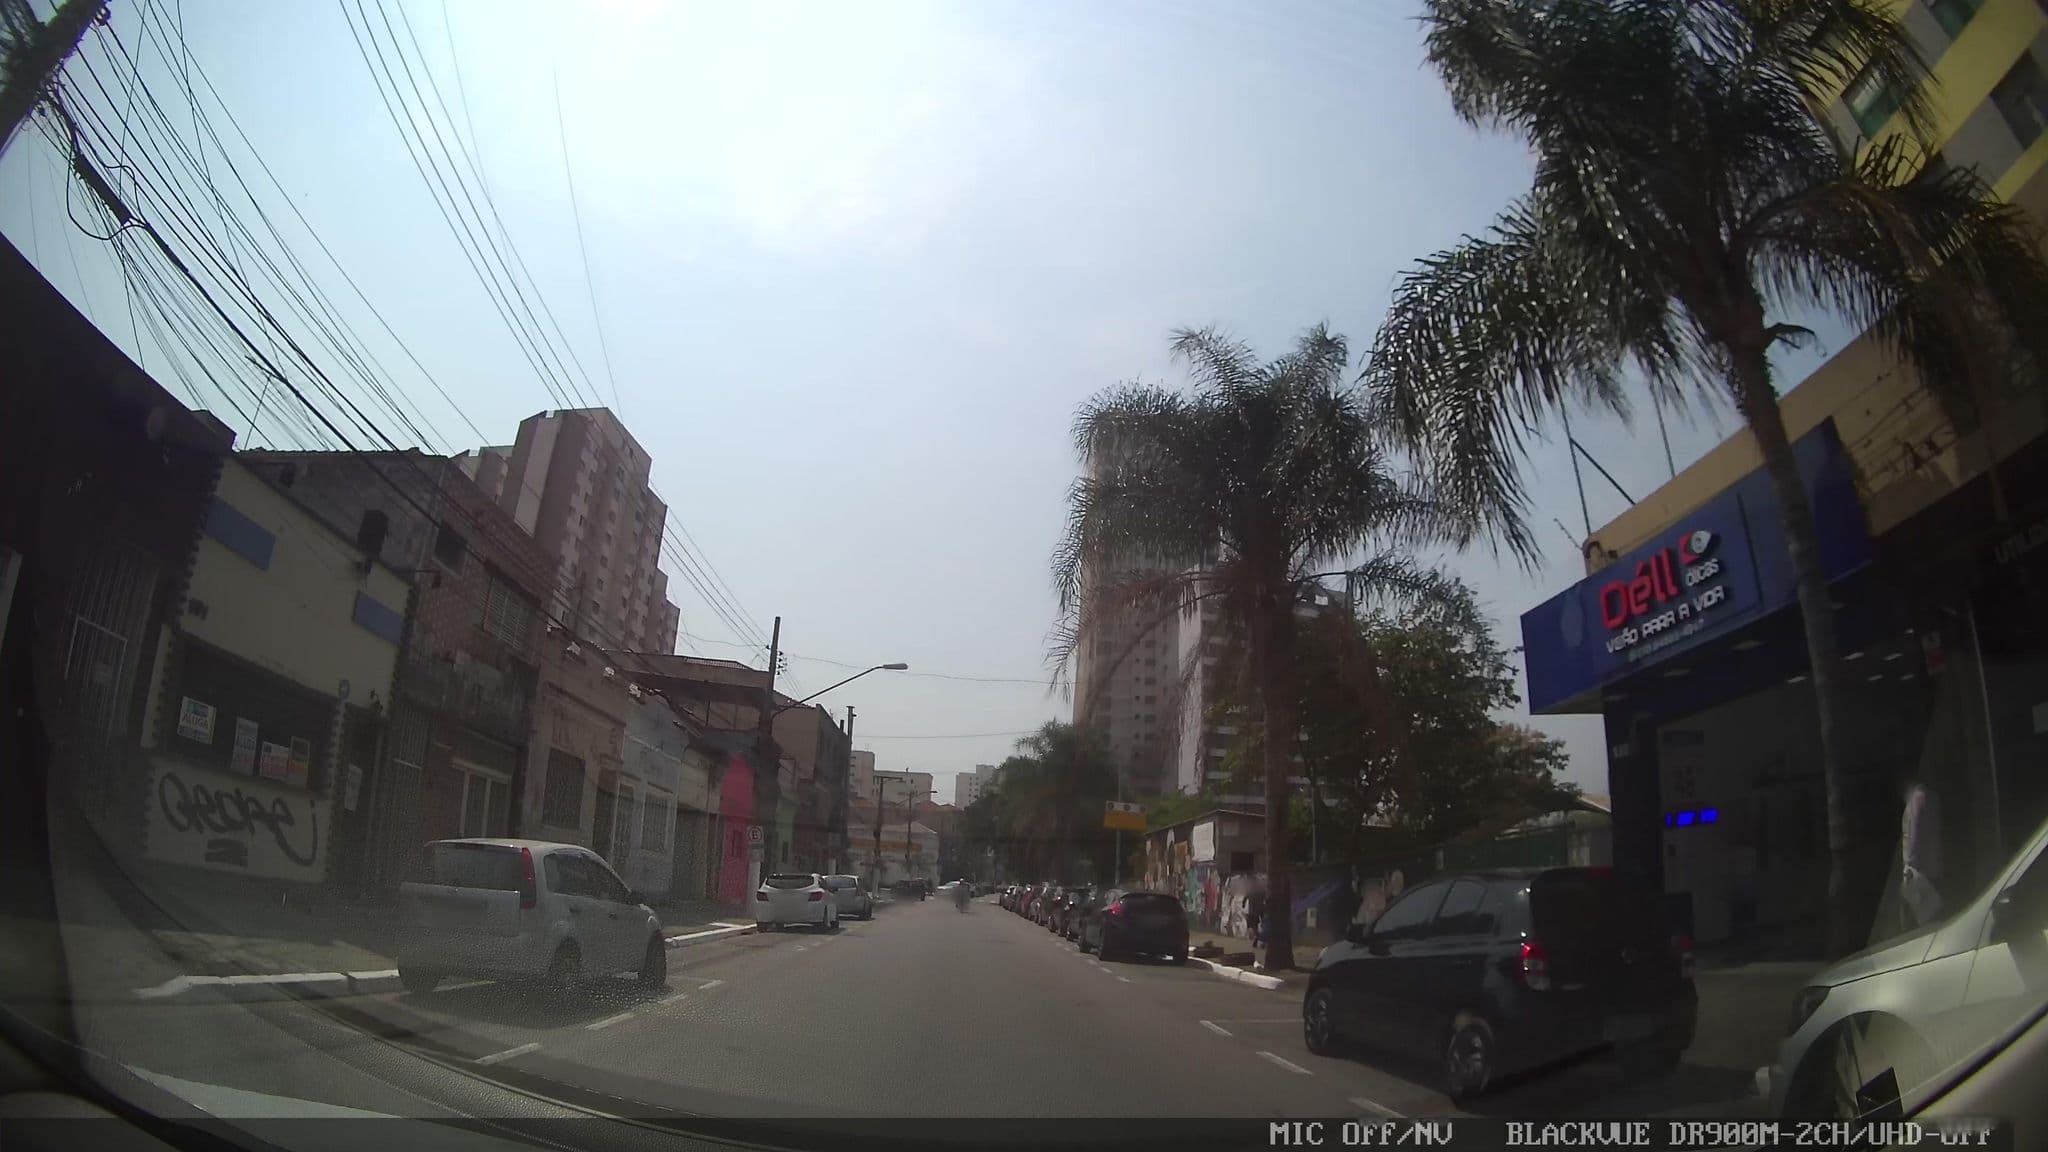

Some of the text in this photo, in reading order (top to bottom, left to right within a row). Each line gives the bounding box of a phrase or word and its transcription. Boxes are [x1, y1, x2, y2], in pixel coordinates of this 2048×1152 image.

[1600, 548, 1678, 628] Déll
[1642, 611, 1675, 637] PARA
[1678, 602, 1691, 620] A
[1693, 585, 1724, 611] VIDA
